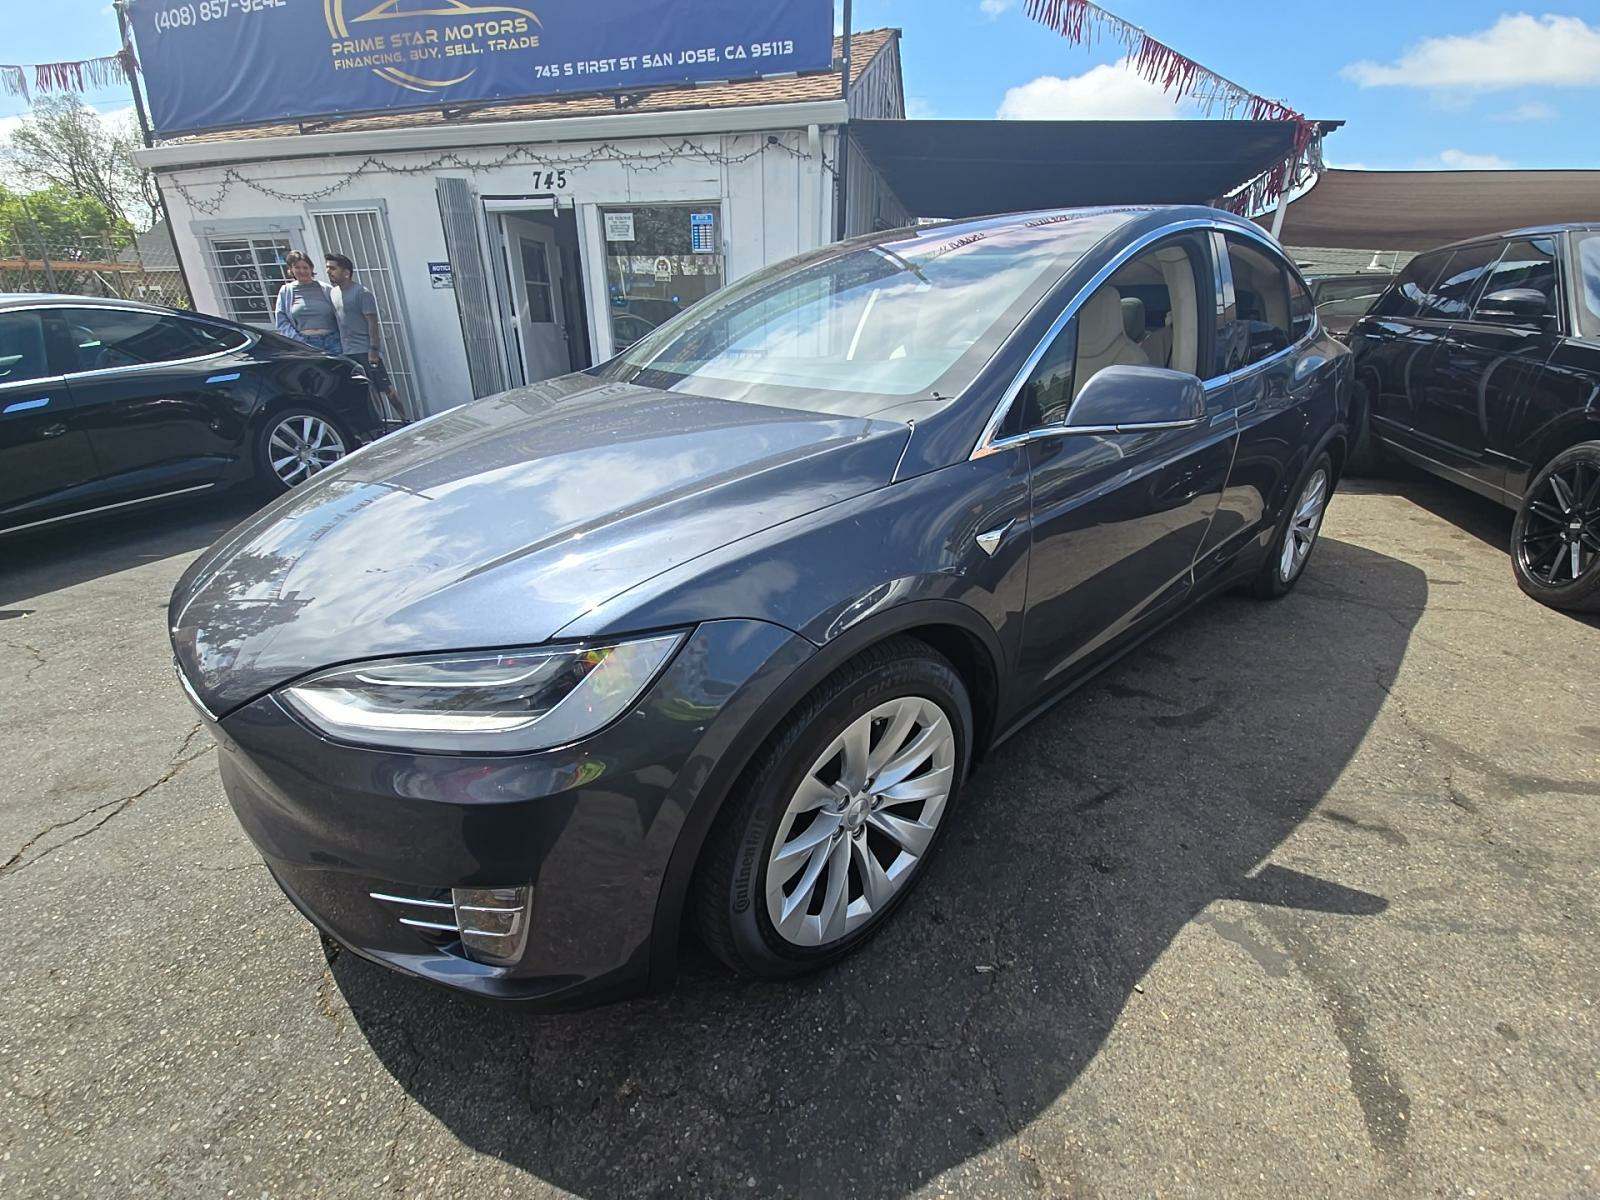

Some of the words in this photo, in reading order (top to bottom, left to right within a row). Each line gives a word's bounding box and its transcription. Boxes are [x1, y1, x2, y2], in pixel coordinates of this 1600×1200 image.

[154, 3, 197, 34] (408)
[331, 36, 386, 56] PRIME
[390, 29, 438, 47] STAR
[444, 17, 528, 42] MOTORS
[410, 47, 442, 62] BUY,
[445, 43, 484, 57] SELL,
[488, 35, 540, 51] TRADE
[534, 64, 560, 79] 745
[563, 62, 574, 76] S
[577, 58, 617, 75] FIRST
[620, 56, 638, 71] ST
[642, 52, 673, 69] SAN
[678, 47, 720, 64] JOSE,
[724, 44, 747, 60] CA
[751, 39, 794, 57] 95113
[532, 170, 567, 190] 745
